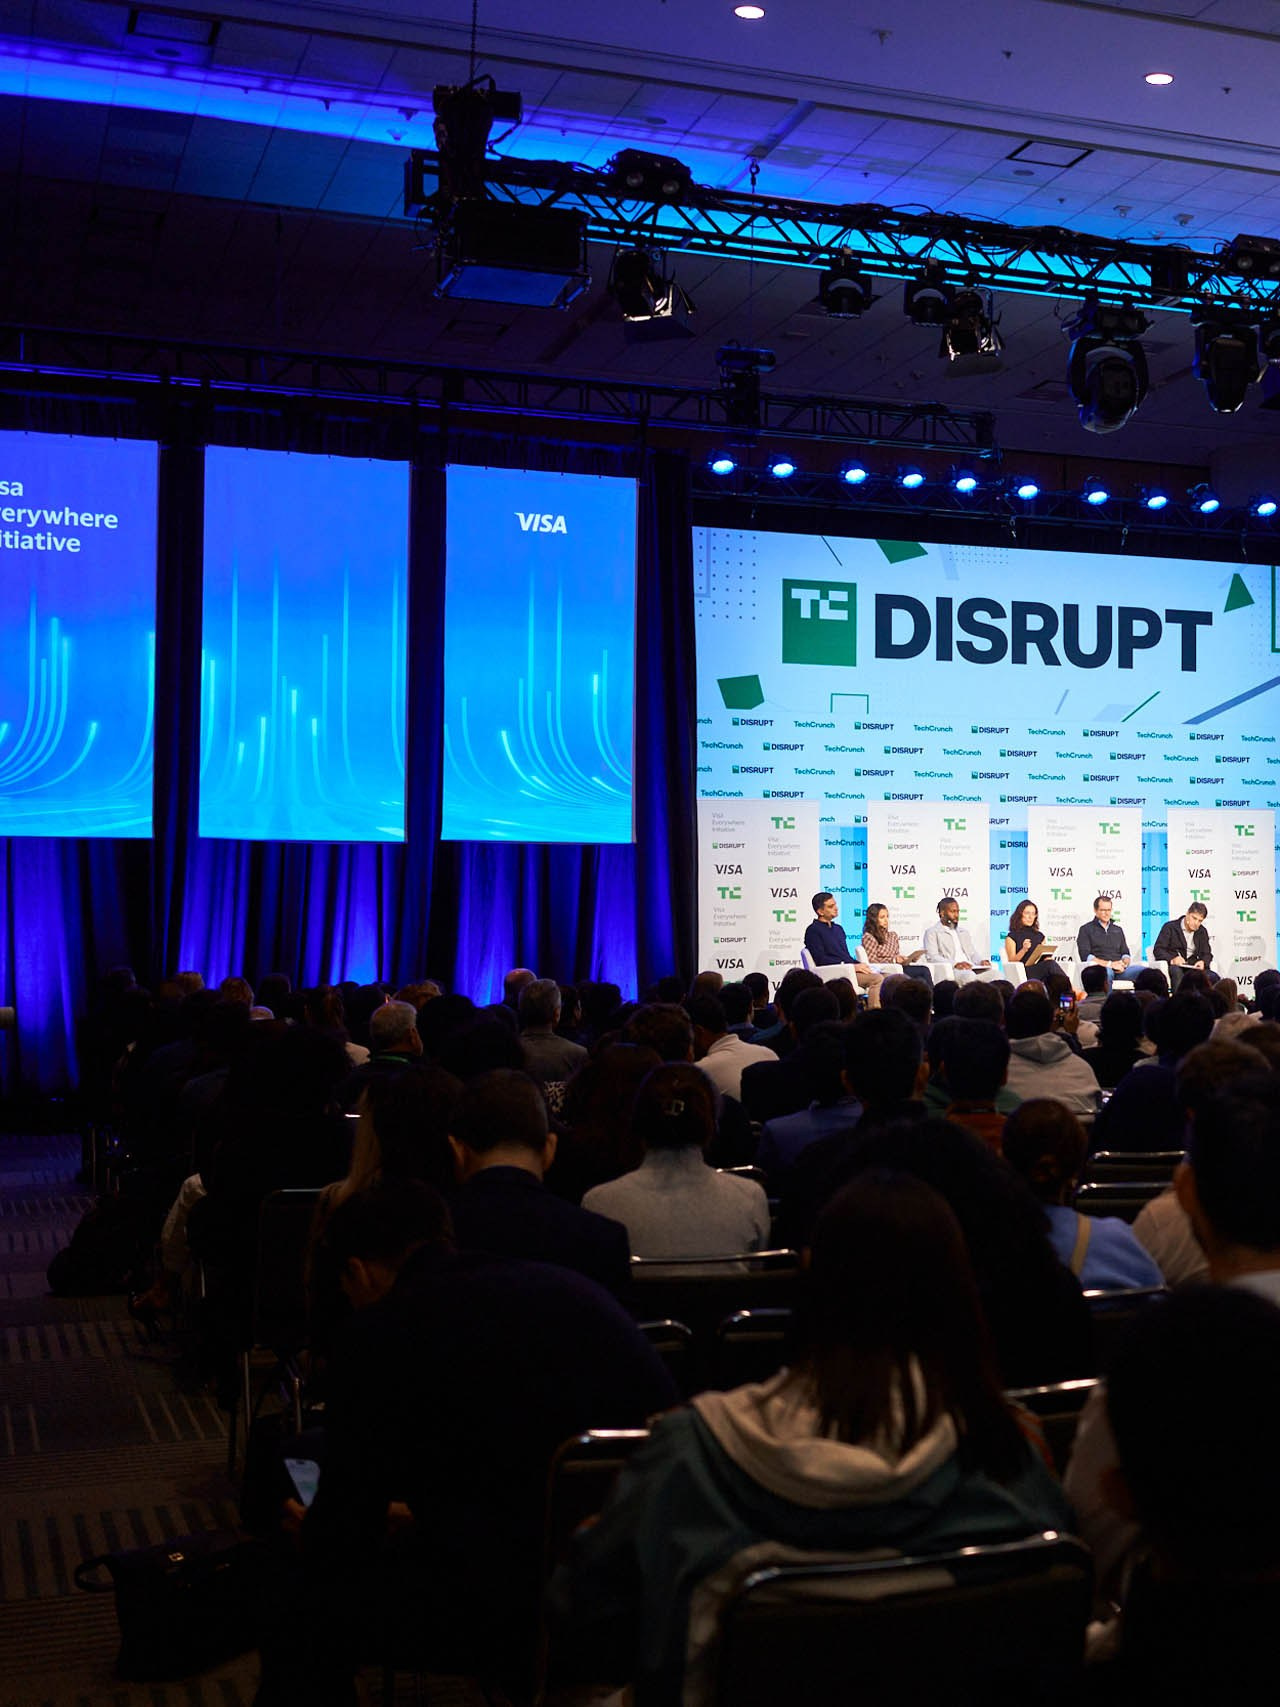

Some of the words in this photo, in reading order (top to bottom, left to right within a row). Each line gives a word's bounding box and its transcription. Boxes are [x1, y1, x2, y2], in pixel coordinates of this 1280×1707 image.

[515, 512, 567, 534] VISA
[874, 593, 1213, 672] DISRUPT
[771, 817, 795, 829] TC
[944, 819, 966, 830] TC
[1099, 823, 1120, 834] TC
[1235, 825, 1255, 836] TC
[714, 864, 742, 874] VISA
[891, 865, 916, 874] VISA
[1049, 868, 1073, 877] VISA
[1188, 869, 1211, 878] VISA
[717, 887, 741, 899] TC
[770, 888, 798, 898] VISA
[892, 887, 915, 898] TC
[943, 888, 968, 897] VISA
[1051, 889, 1072, 900] TC
[1098, 890, 1122, 899] VISA
[1235, 890, 1257, 899] VISA
[773, 910, 796, 922] TC
[1237, 911, 1256, 921] TC
[716, 959, 744, 968] VISA
[1237, 976, 1254, 985] VIS
